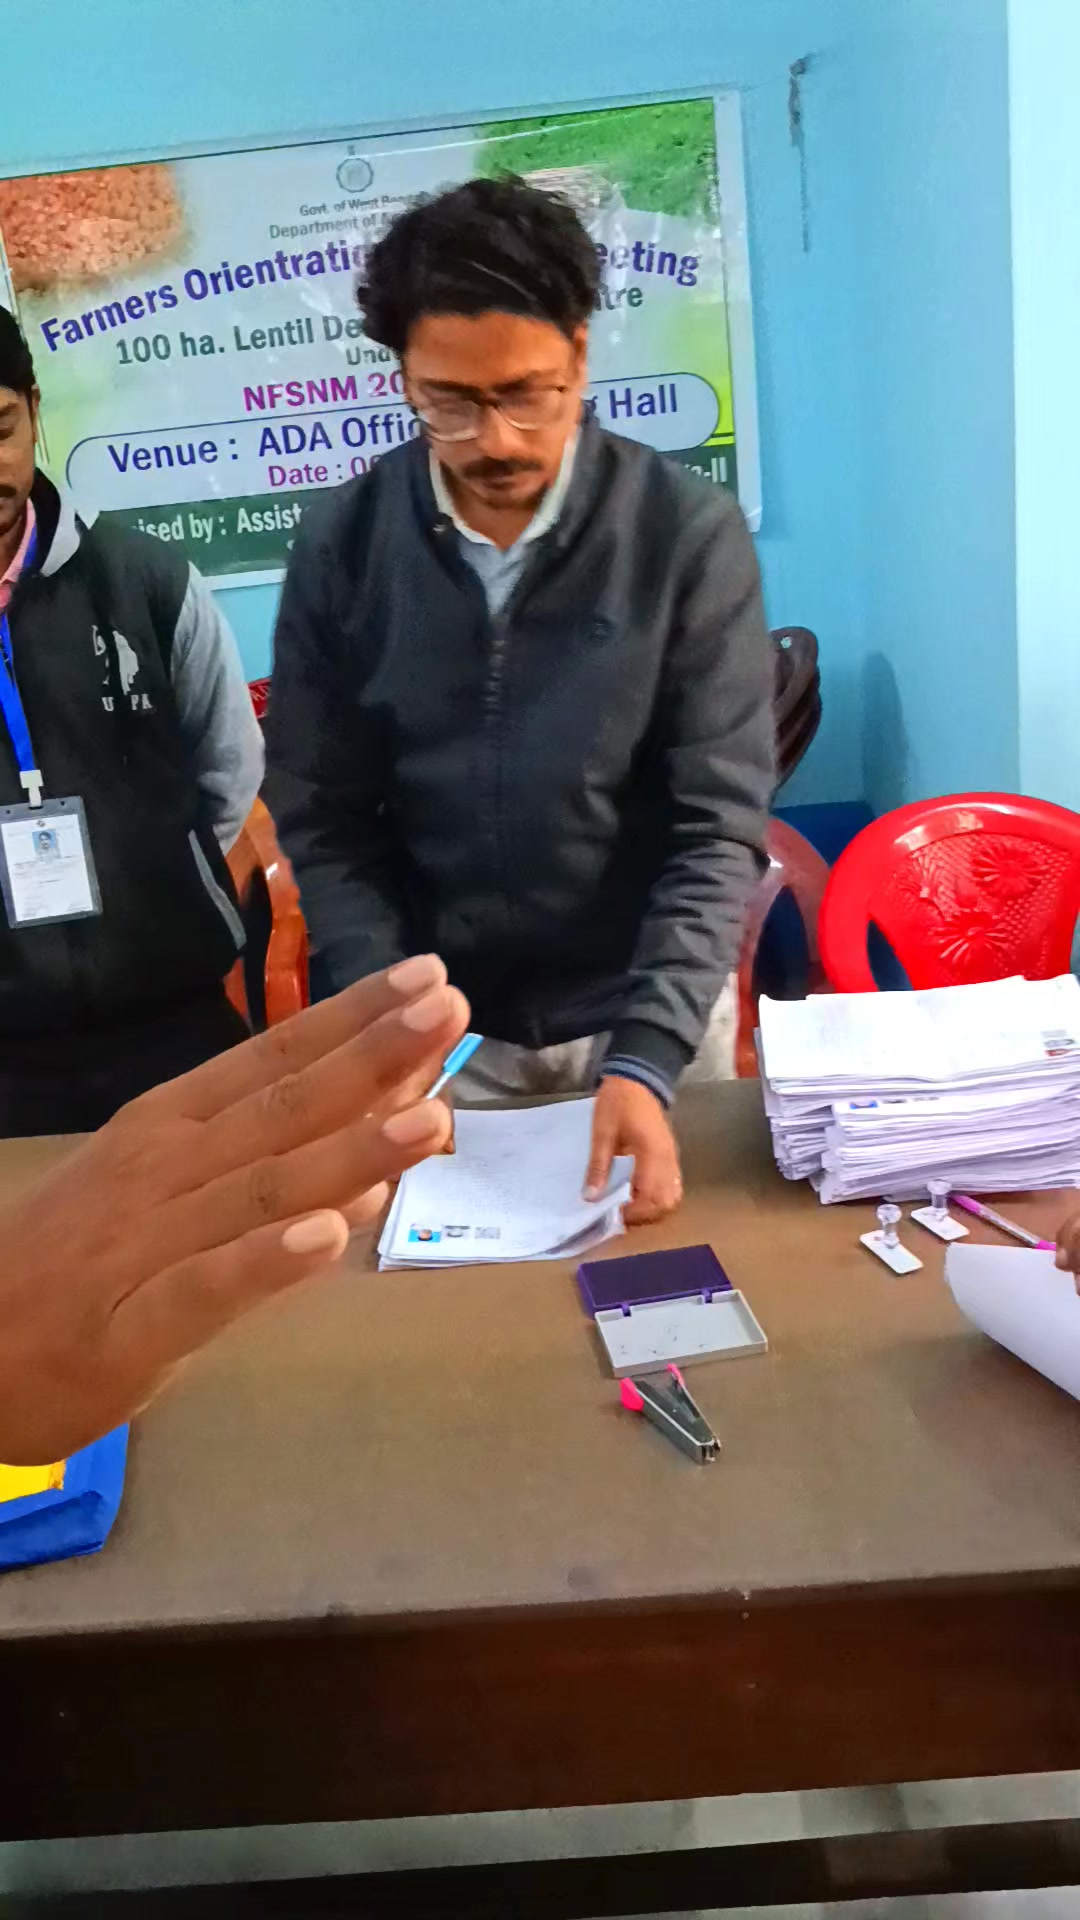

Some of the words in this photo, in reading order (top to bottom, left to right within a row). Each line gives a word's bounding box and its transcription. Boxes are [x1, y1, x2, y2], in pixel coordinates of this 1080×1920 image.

[334, 201, 346, 212] of
[269, 217, 359, 239] Department
[41, 283, 178, 352] Farmers
[183, 239, 366, 301] Orientratio
[594, 240, 699, 287] eeting
[116, 335, 171, 364] 100
[179, 331, 225, 358] ha.
[234, 318, 314, 352] Lentil
[322, 315, 363, 341] De
[243, 375, 358, 411] NFSNM
[367, 369, 406, 397] 20
[108, 436, 218, 473] Venue
[259, 421, 332, 457] ADA
[341, 412, 421, 448] Offic
[609, 383, 678, 419] Hall
[269, 463, 328, 487] Date
[237, 502, 302, 533] Assist
